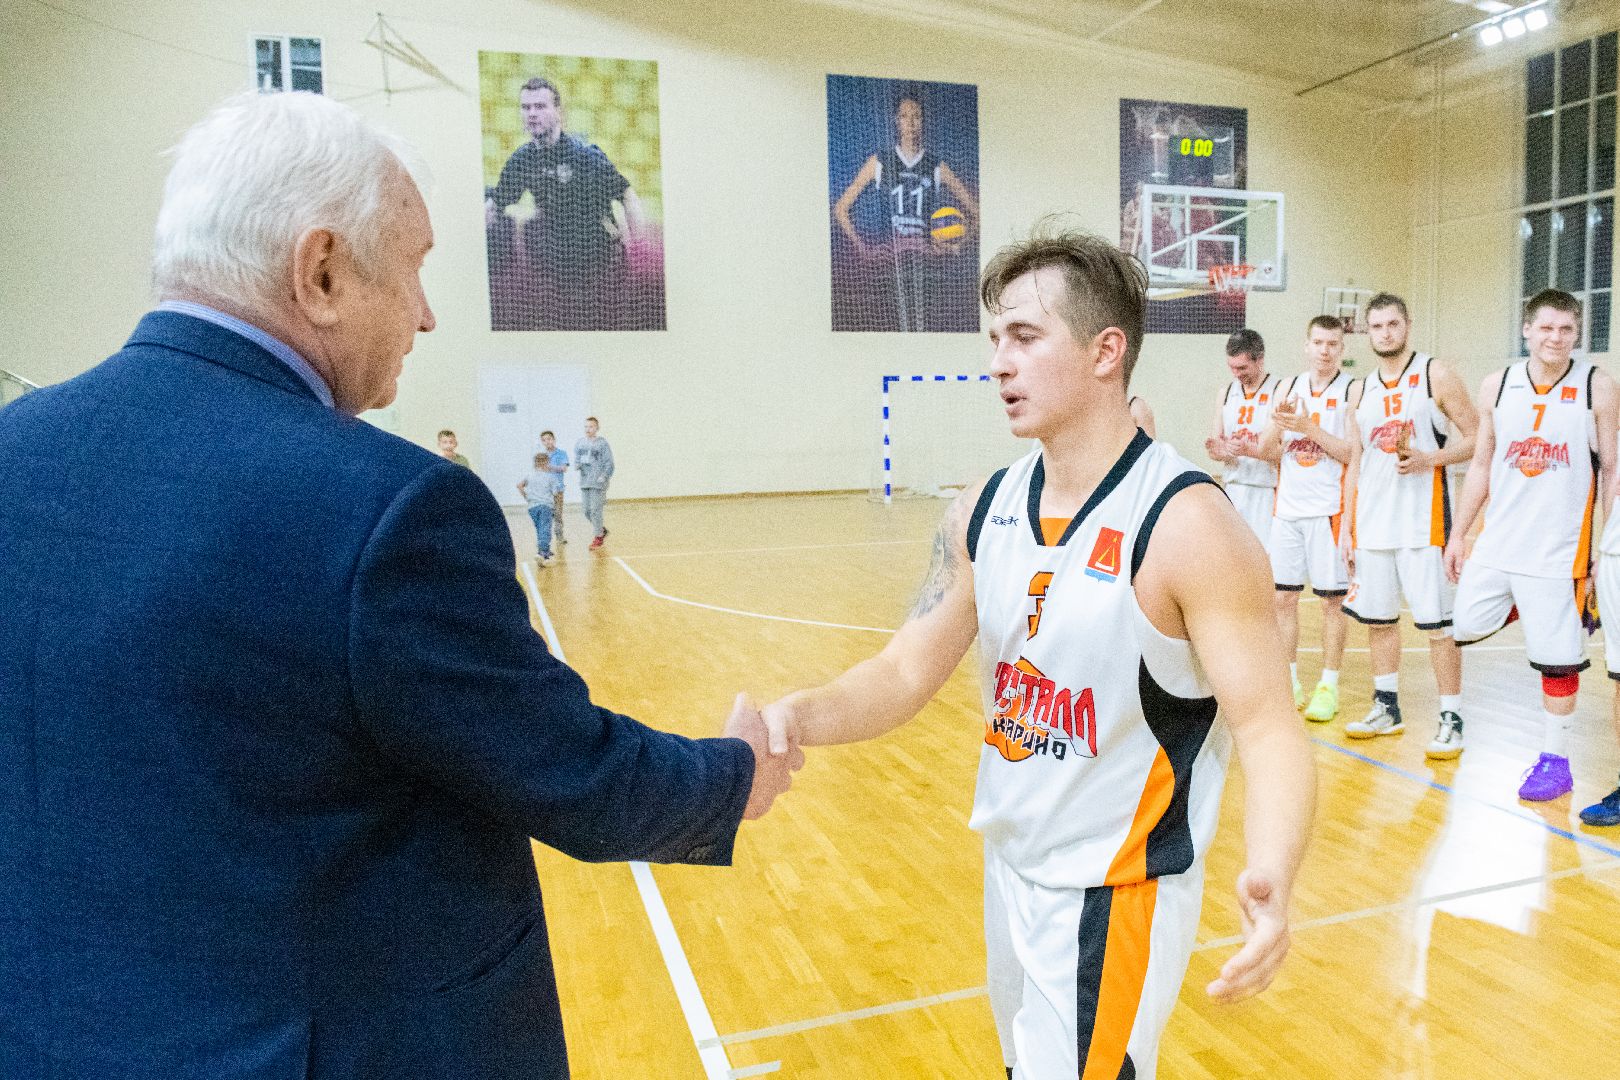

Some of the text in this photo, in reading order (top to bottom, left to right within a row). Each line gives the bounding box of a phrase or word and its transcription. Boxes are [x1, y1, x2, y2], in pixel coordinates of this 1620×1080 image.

[891, 184, 923, 215] 11
[1383, 392, 1403, 418] 15
[1532, 404, 1547, 432] 7
